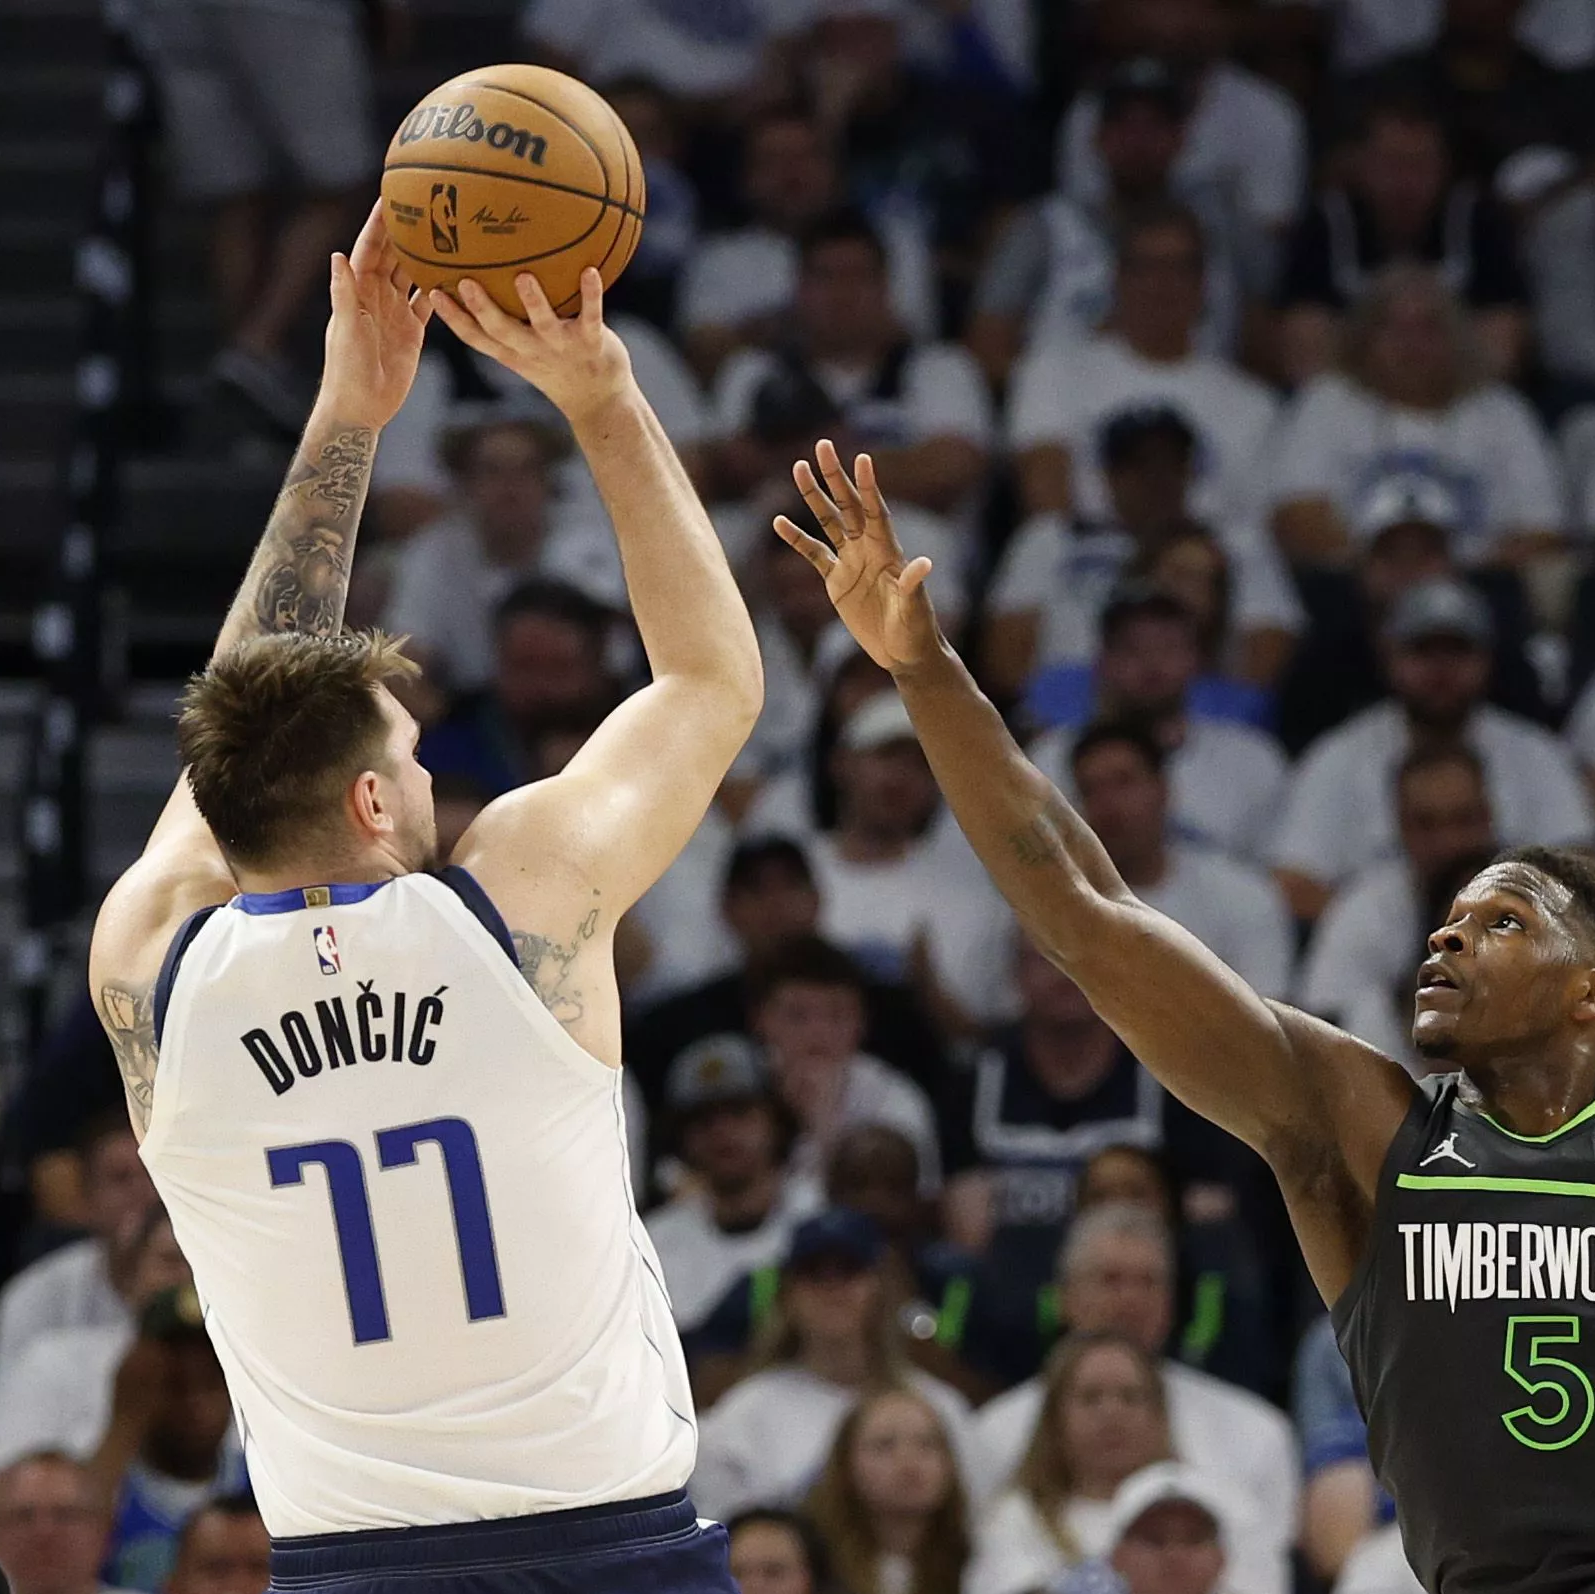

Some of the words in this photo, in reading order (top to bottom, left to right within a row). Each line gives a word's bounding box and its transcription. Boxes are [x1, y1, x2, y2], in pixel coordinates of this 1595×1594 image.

[399, 104, 547, 166] Wilson
[240, 979, 449, 1096] DONČIĆ
[264, 1115, 507, 1347] 77
[1502, 1315, 1594, 1450] 5
